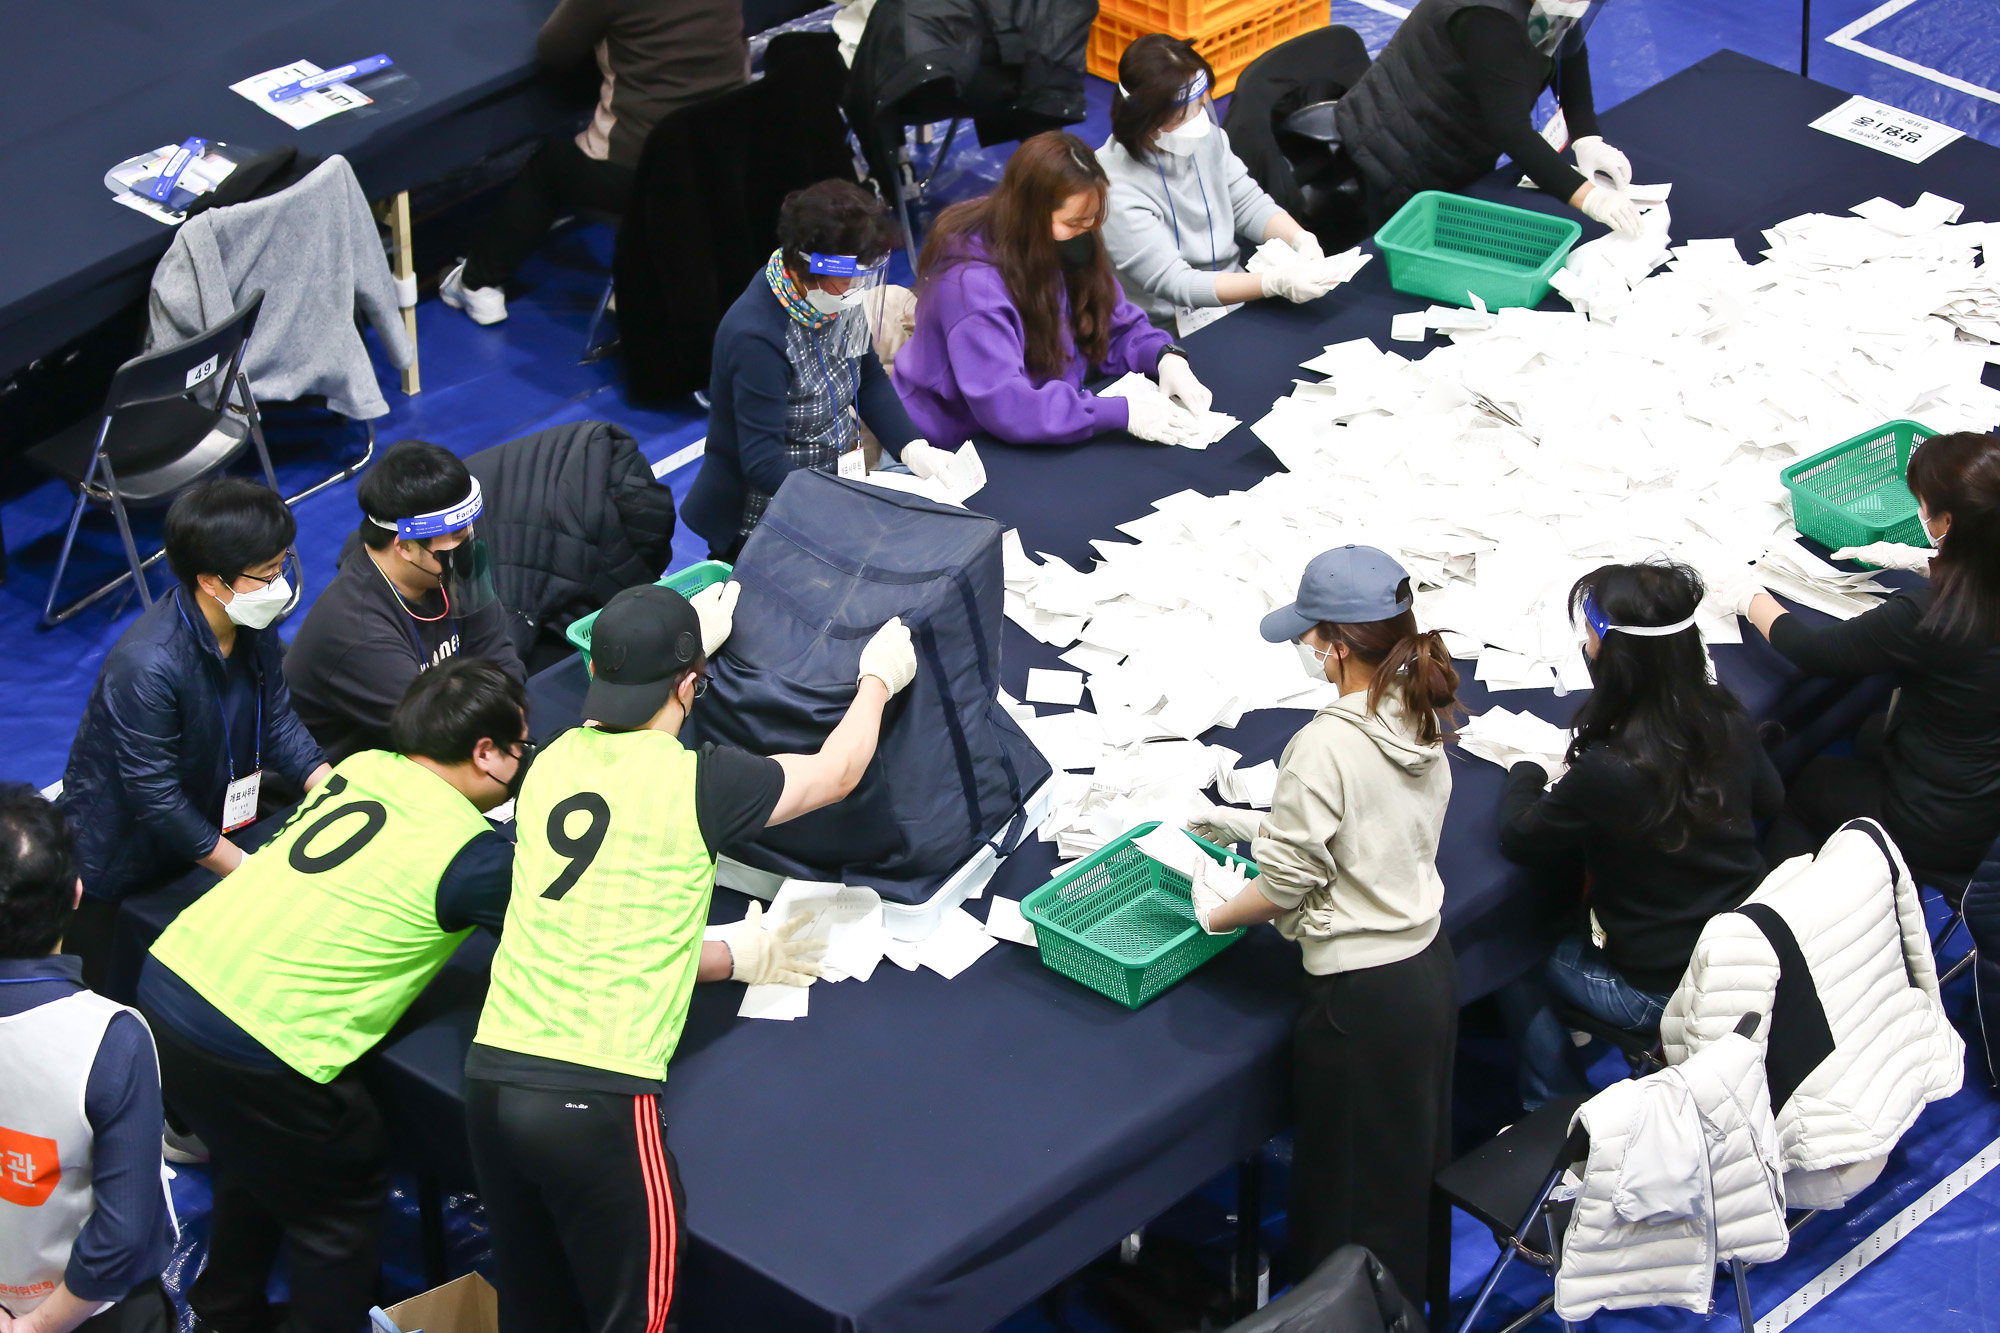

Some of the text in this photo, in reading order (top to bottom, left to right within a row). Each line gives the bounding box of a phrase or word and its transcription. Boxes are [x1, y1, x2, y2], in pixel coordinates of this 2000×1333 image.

[1851, 116, 1922, 144] 망원1동
[195, 362, 211, 380] 49
[539, 792, 611, 901] 9
[0, 1150, 36, 1188] 관
